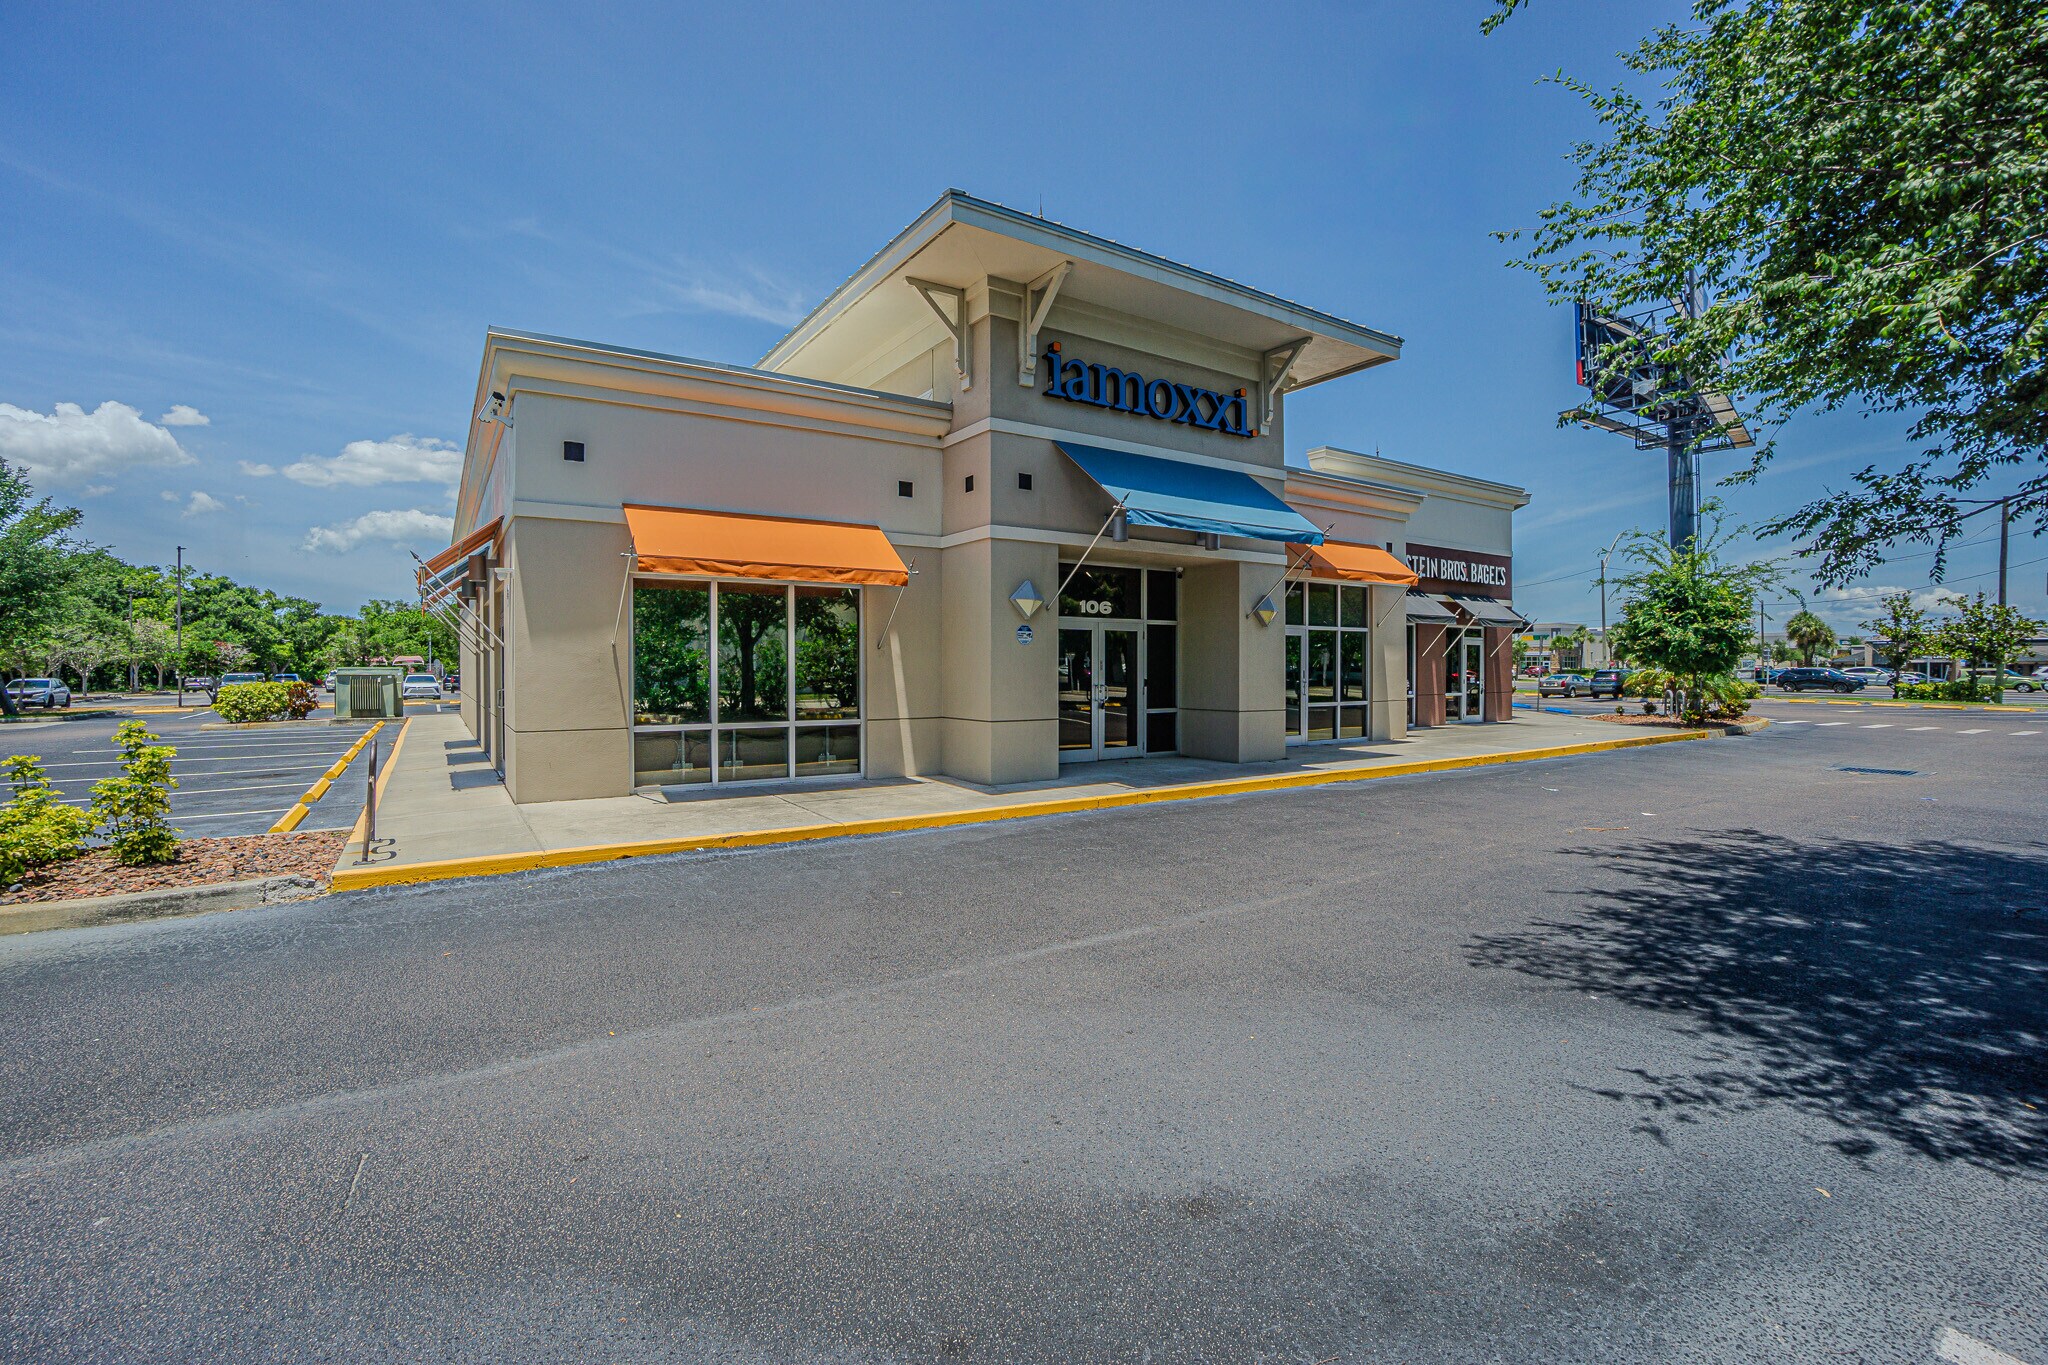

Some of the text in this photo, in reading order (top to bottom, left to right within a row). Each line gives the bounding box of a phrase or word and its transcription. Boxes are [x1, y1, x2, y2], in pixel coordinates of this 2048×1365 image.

[1440, 558, 1469, 582] BROS.
[1470, 562, 1507, 586] BAGELS
[1079, 599, 1113, 615] 106
